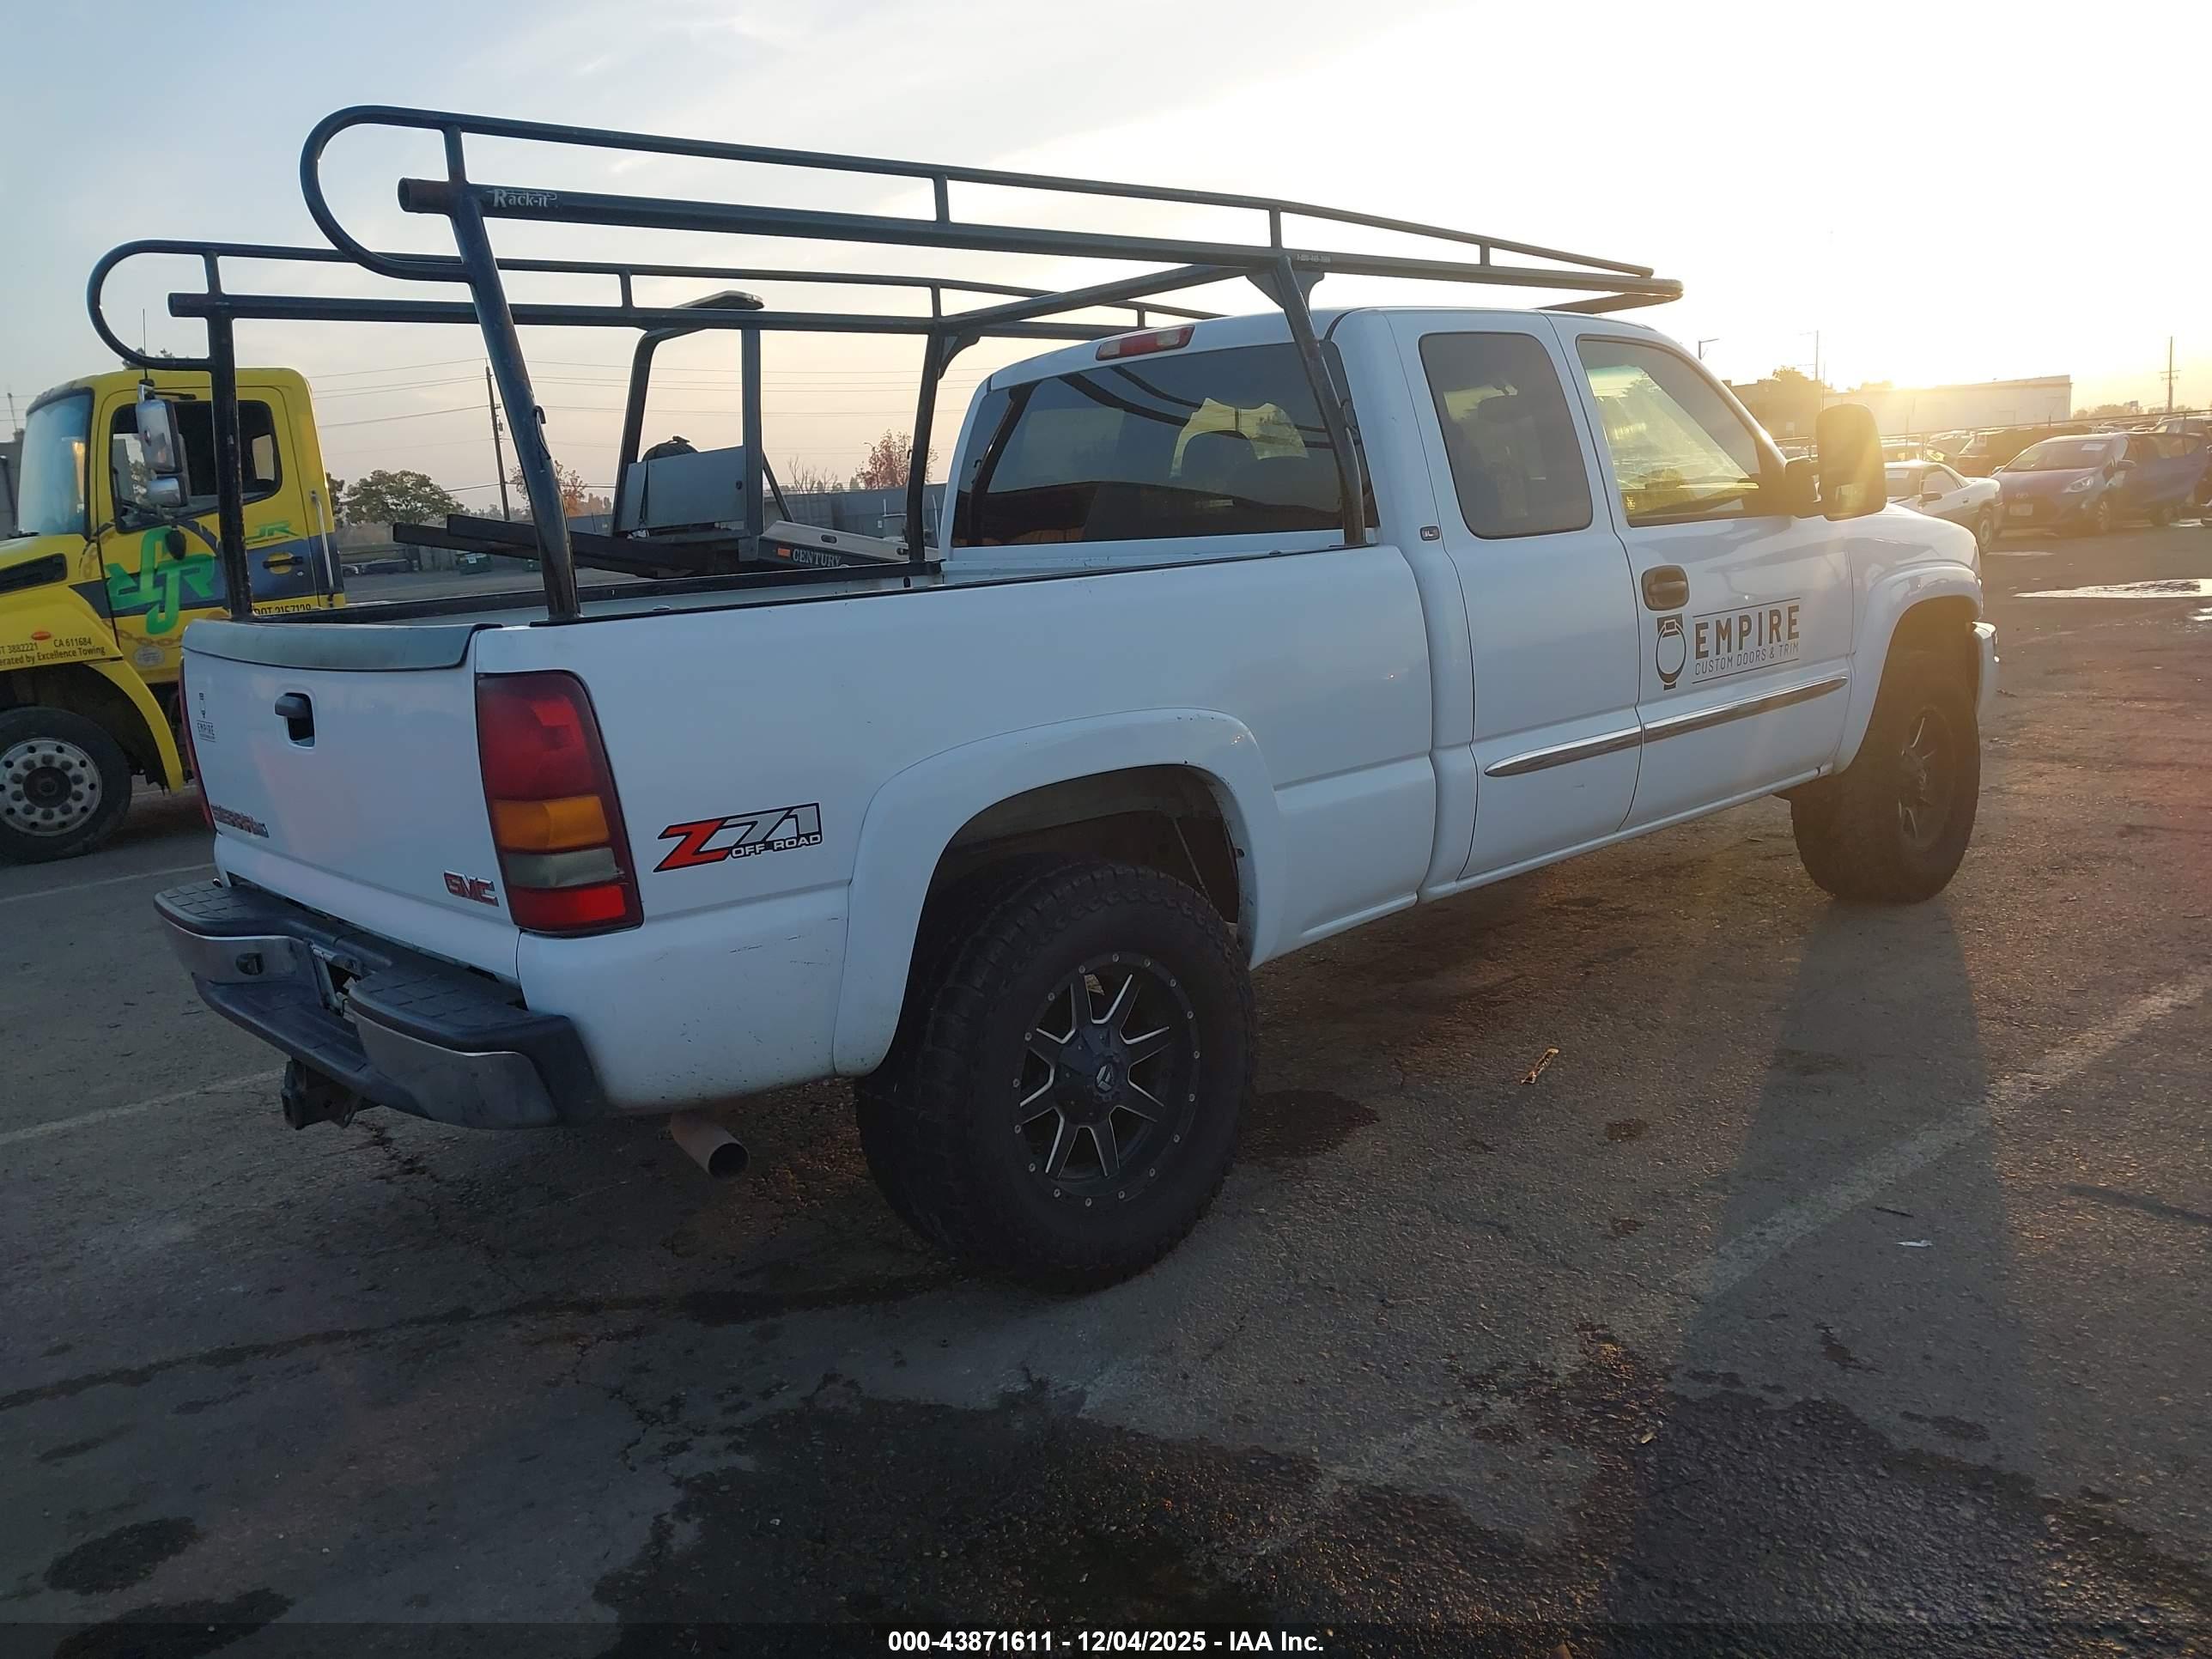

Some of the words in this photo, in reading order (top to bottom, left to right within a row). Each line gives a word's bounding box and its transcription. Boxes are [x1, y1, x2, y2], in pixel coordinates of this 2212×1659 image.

[793, 548, 841, 568] CENTURY
[53, 639, 65, 647] CA
[66, 637, 92, 647] 611684
[1695, 605, 1800, 659] EMPIRE
[26, 653, 34, 665] by
[37, 651, 76, 661] Excellence
[78, 646, 106, 657] Towing
[1695, 654, 1733, 675] CUSTOM
[1736, 648, 1766, 666] DOORS
[1770, 646, 1775, 659] &
[1778, 641, 1799, 658] TRIM
[653, 802, 822, 872] Z71
[731, 842, 767, 858] OFF
[772, 834, 821, 852] ROAD
[443, 869, 500, 907] GMC
